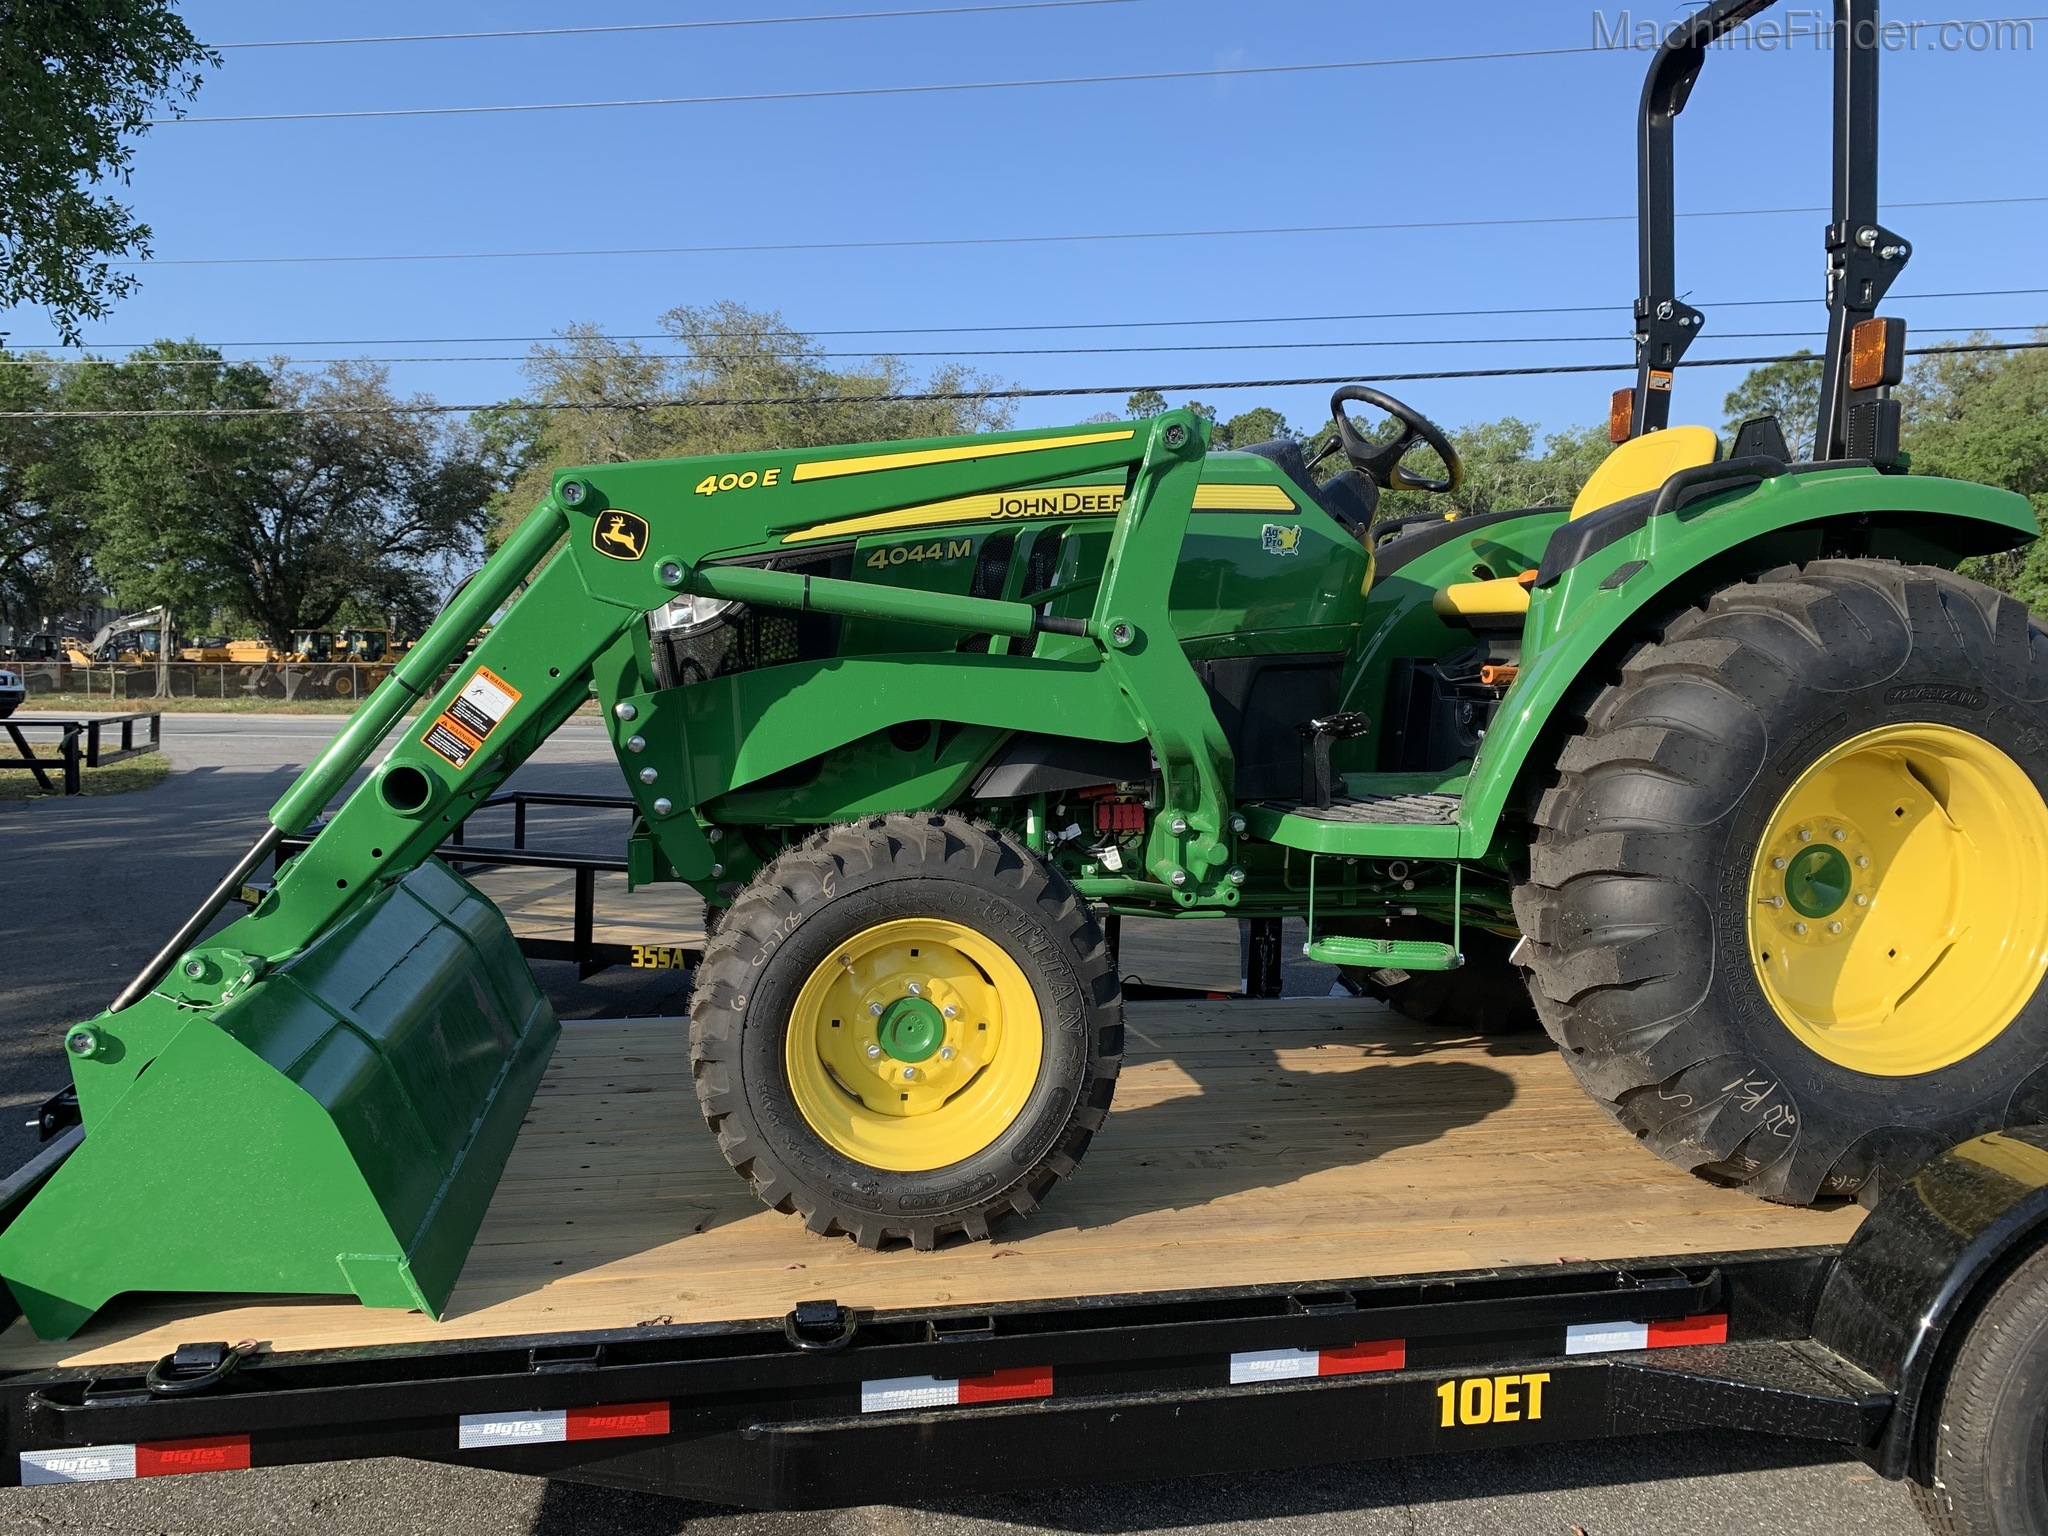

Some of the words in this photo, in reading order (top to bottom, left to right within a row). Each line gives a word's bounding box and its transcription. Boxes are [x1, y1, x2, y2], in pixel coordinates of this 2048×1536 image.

[694, 470, 759, 497] 400
[761, 467, 782, 488] E
[990, 496, 1058, 518] JOHN
[1062, 492, 1124, 513] DEER
[866, 542, 944, 570] 4044
[947, 538, 973, 560] M
[489, 674, 516, 698] WARNING
[449, 724, 477, 747] WARNING
[1437, 1372, 1551, 1428] 10ET
